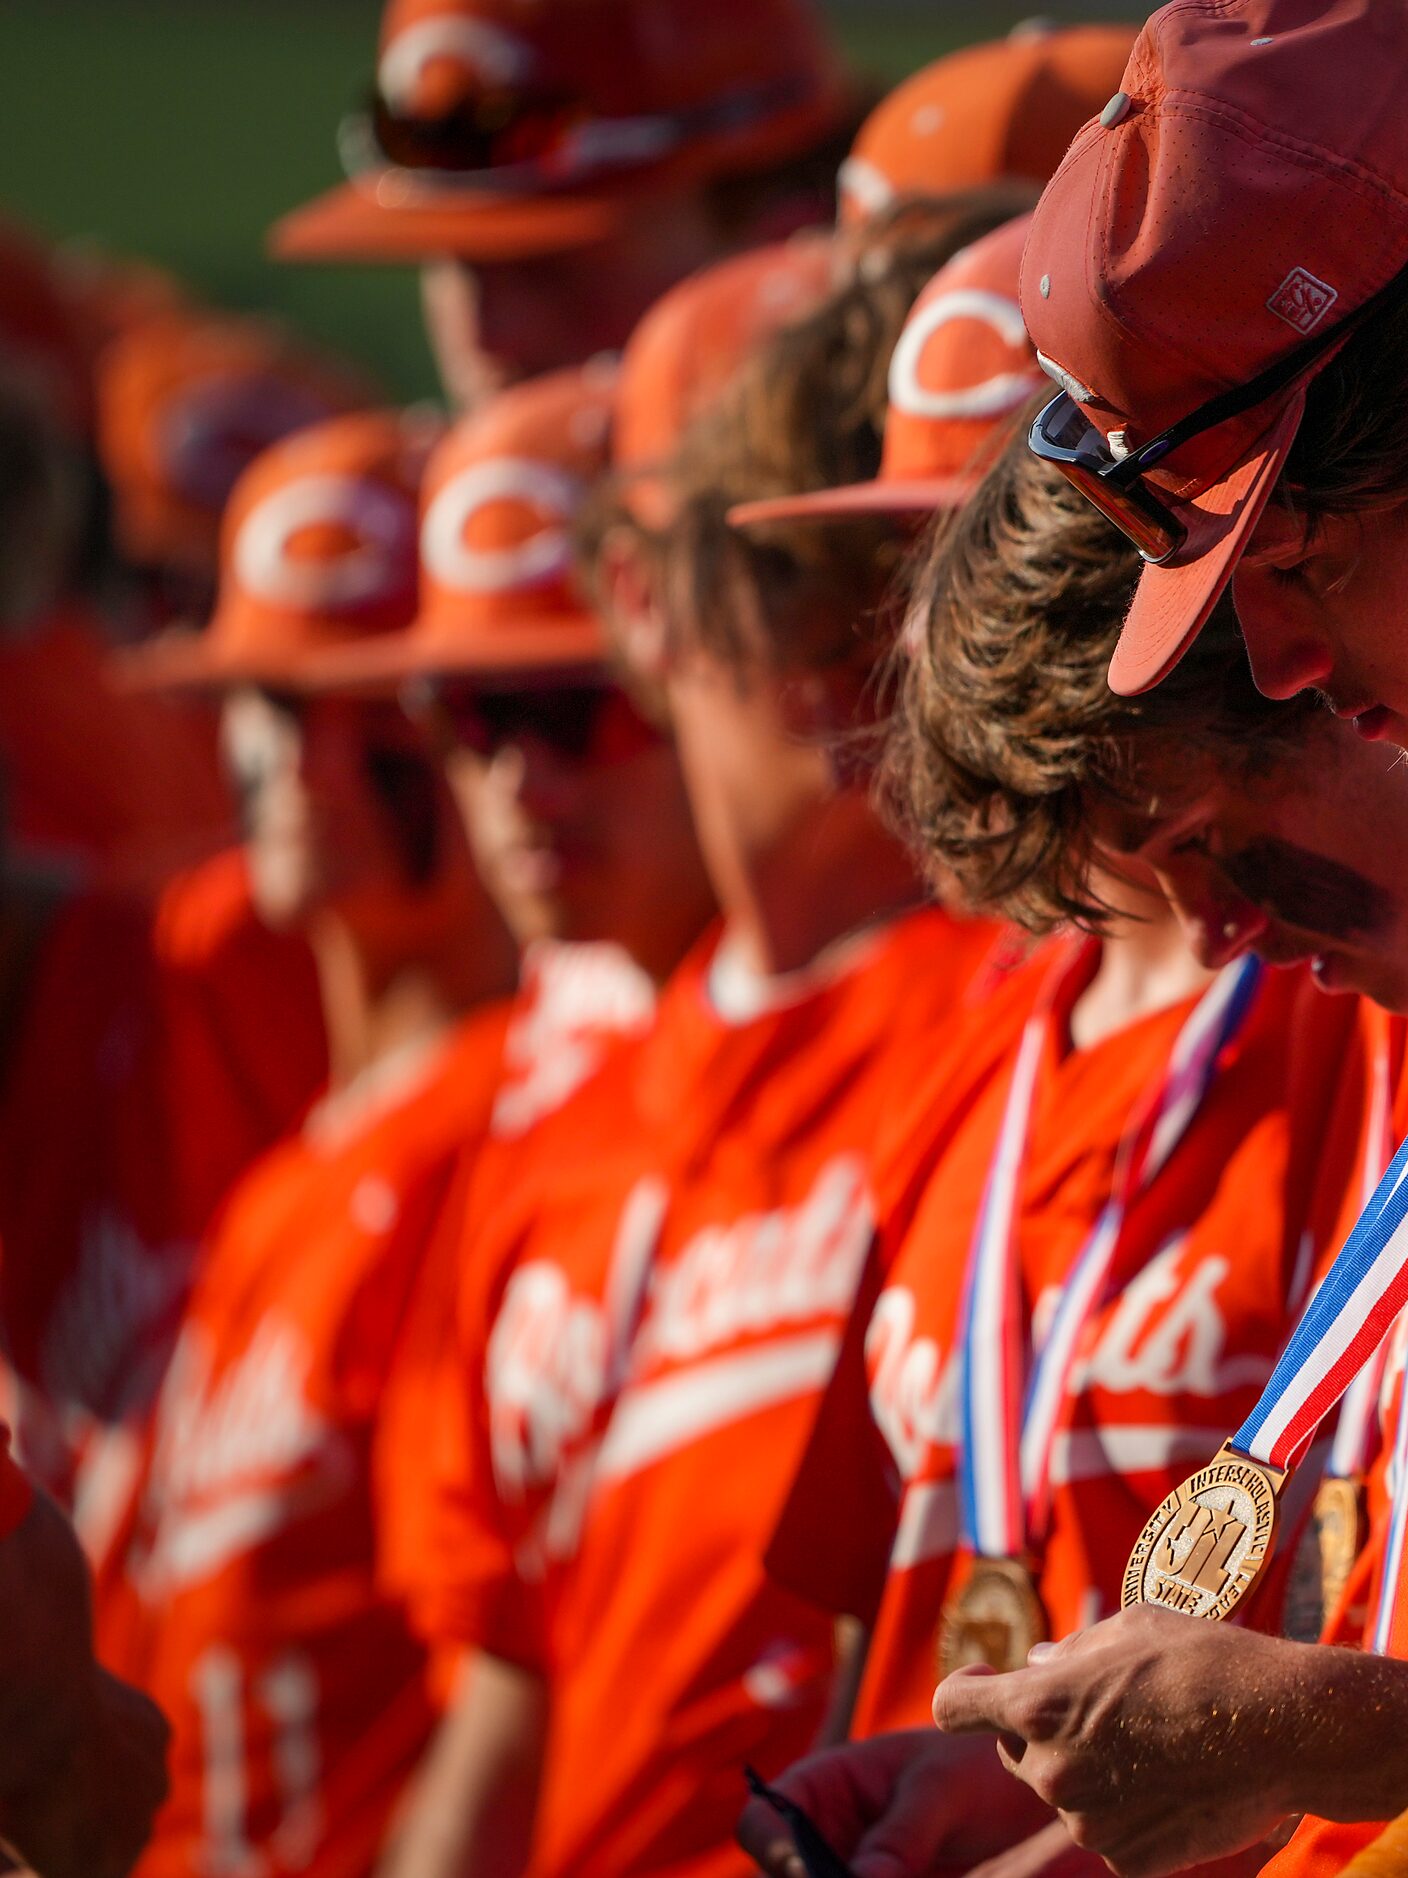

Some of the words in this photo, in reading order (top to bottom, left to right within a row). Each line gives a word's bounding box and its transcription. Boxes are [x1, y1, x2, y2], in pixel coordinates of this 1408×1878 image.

[888, 289, 1038, 418] C
[232, 474, 400, 608] C
[422, 457, 575, 590] C
[1150, 1576, 1203, 1615] STATE
[1203, 1571, 1250, 1620] LEAG
